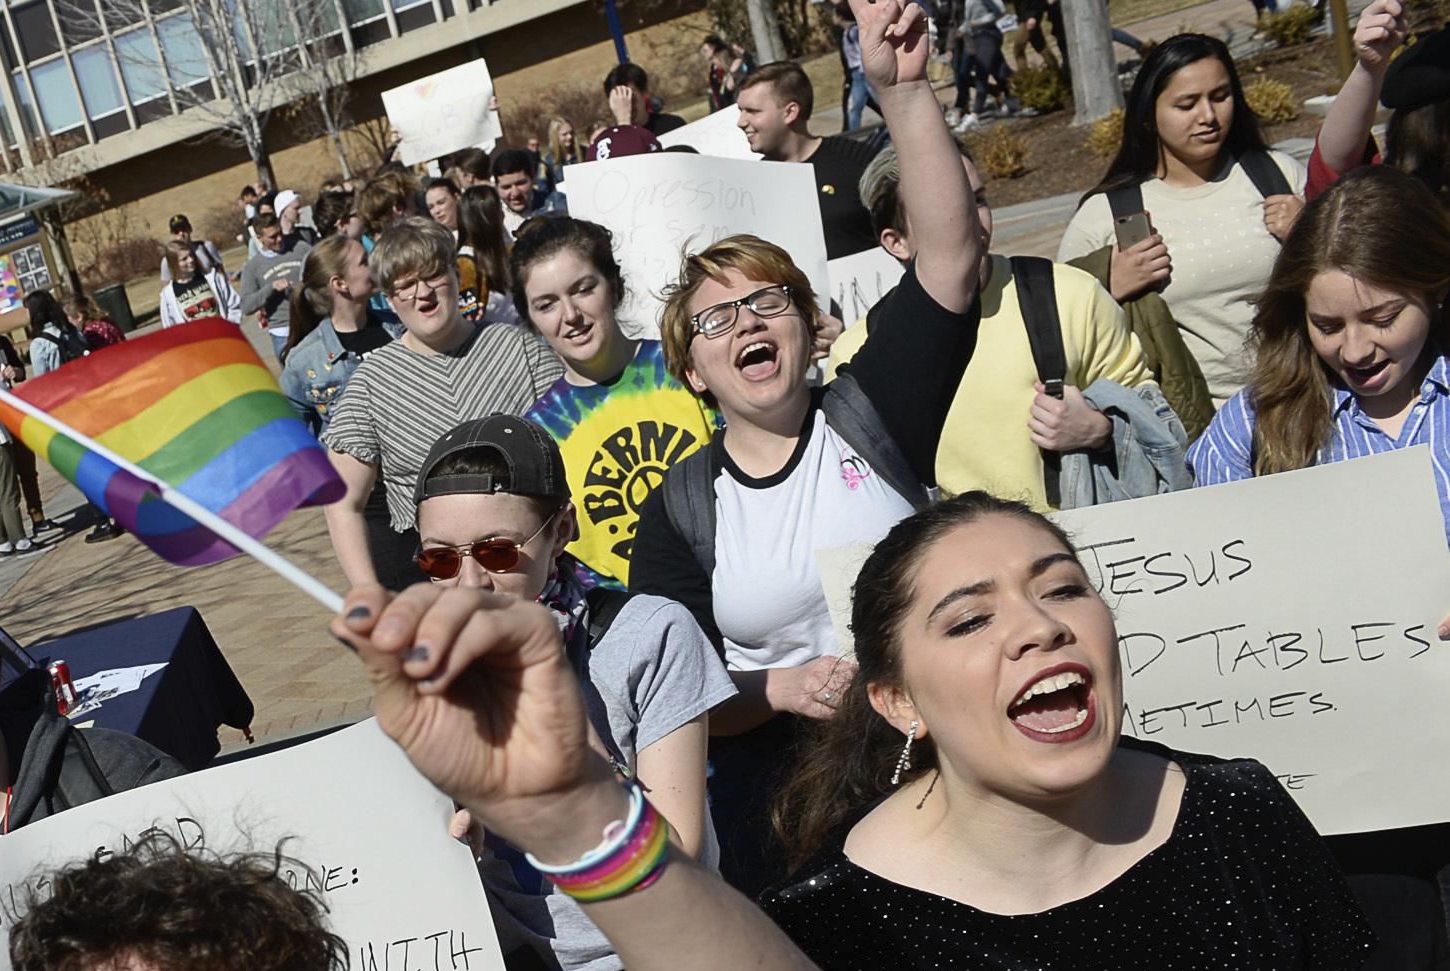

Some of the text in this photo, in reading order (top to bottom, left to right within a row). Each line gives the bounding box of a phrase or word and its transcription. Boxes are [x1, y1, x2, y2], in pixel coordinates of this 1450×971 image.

[583, 420, 697, 526] BERNI
[1077, 537, 1252, 596] JESUS
[1176, 623, 1431, 676] TABLES
[1121, 691, 1338, 736] METIMES.
